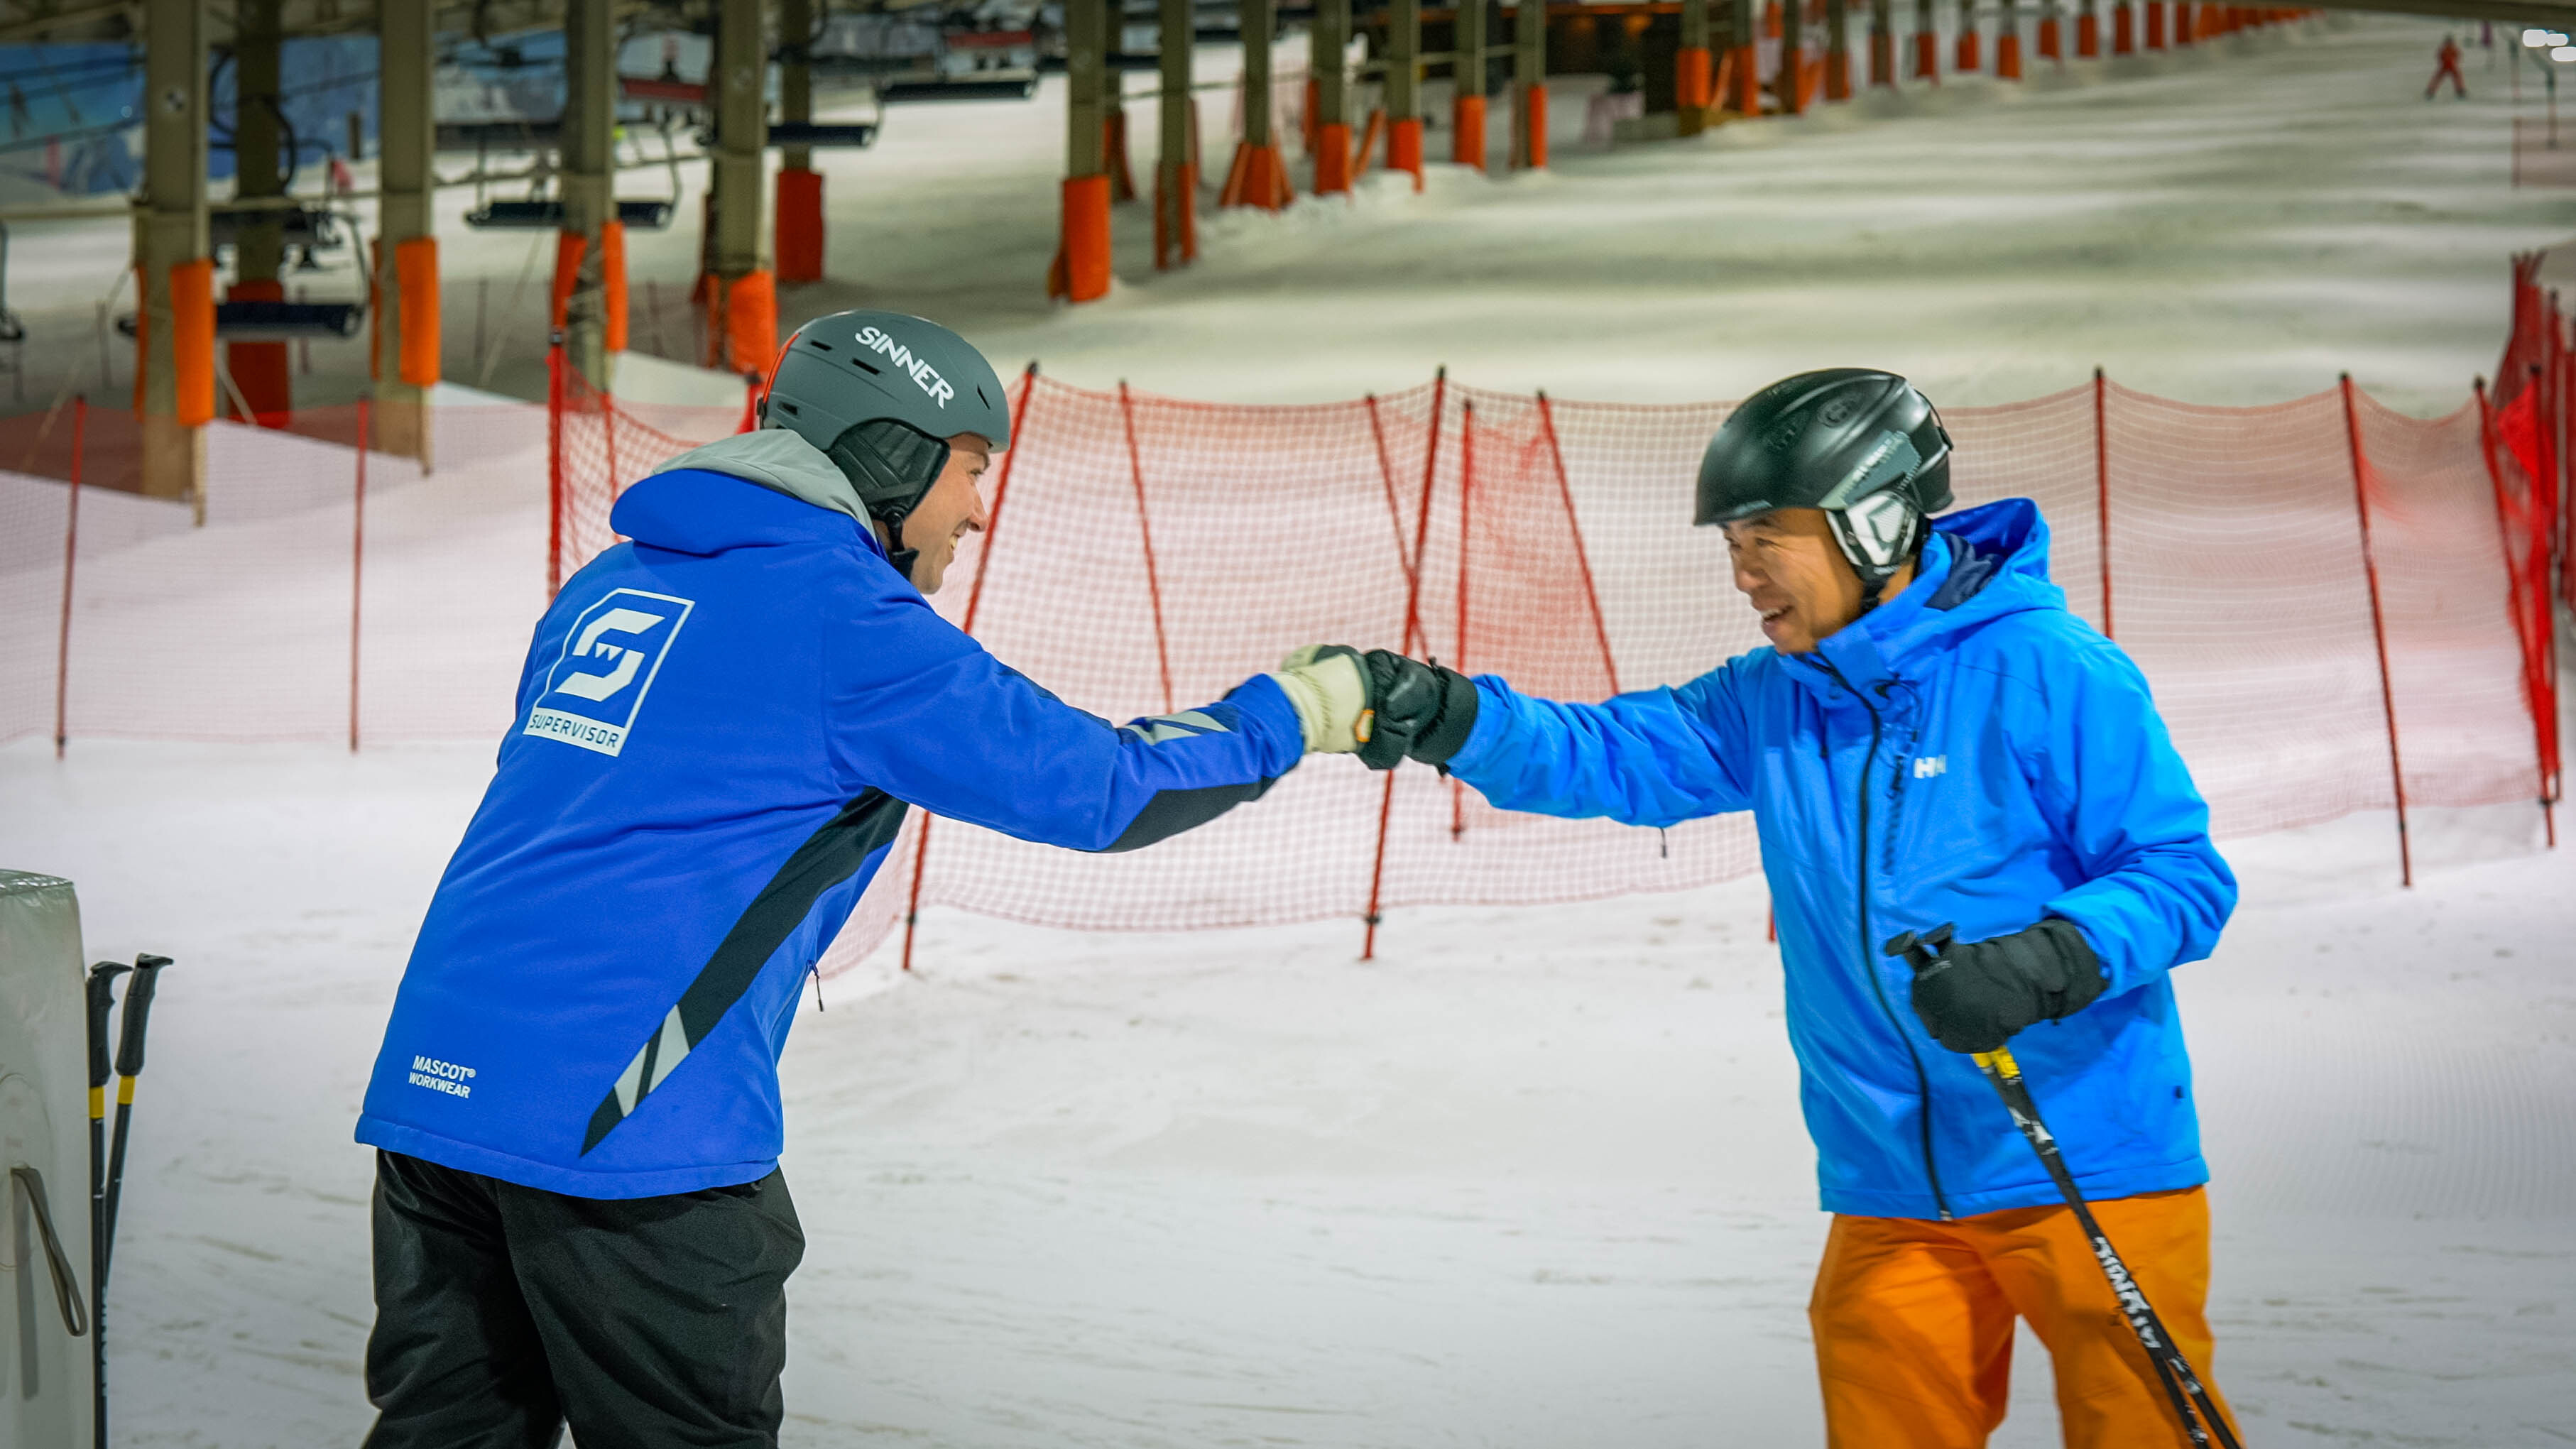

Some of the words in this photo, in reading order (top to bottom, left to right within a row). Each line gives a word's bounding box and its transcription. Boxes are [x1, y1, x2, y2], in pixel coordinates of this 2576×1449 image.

[855, 326, 954, 410] SINNER
[529, 713, 620, 748] SUPERVISOR
[408, 1071, 471, 1099] WORKWEAR
